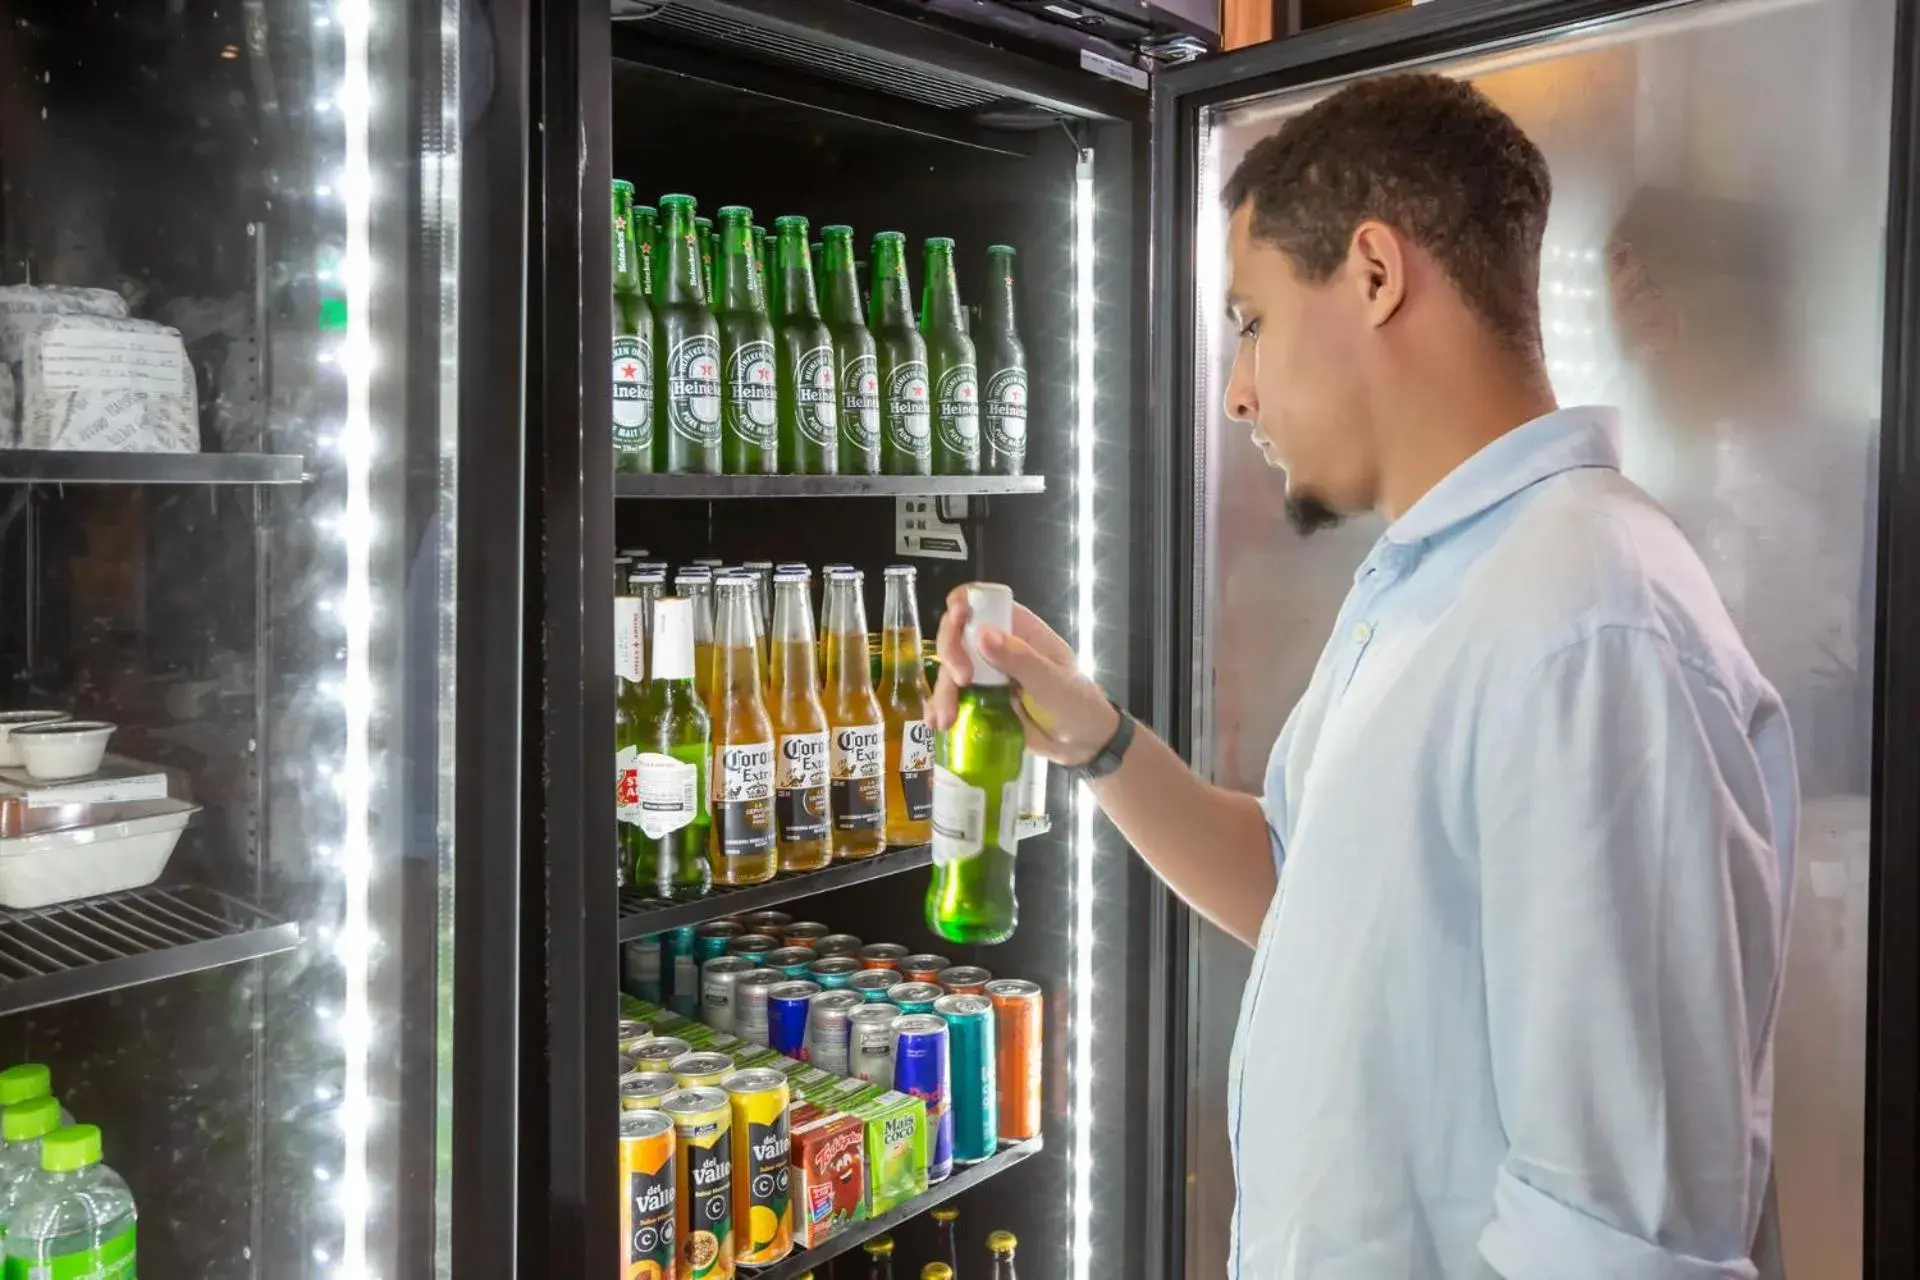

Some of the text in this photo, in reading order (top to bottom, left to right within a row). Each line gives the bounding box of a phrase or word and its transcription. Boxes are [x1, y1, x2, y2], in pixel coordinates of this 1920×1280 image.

[884, 1115, 914, 1136] Mais
[884, 1126, 914, 1145] coco
[752, 1138, 789, 1161] Valle
[763, 1134, 777, 1145] del
[693, 1161, 731, 1185] Valle
[703, 1157, 717, 1169] del
[636, 1187, 675, 1213] Valle
[647, 1184, 661, 1196] del
